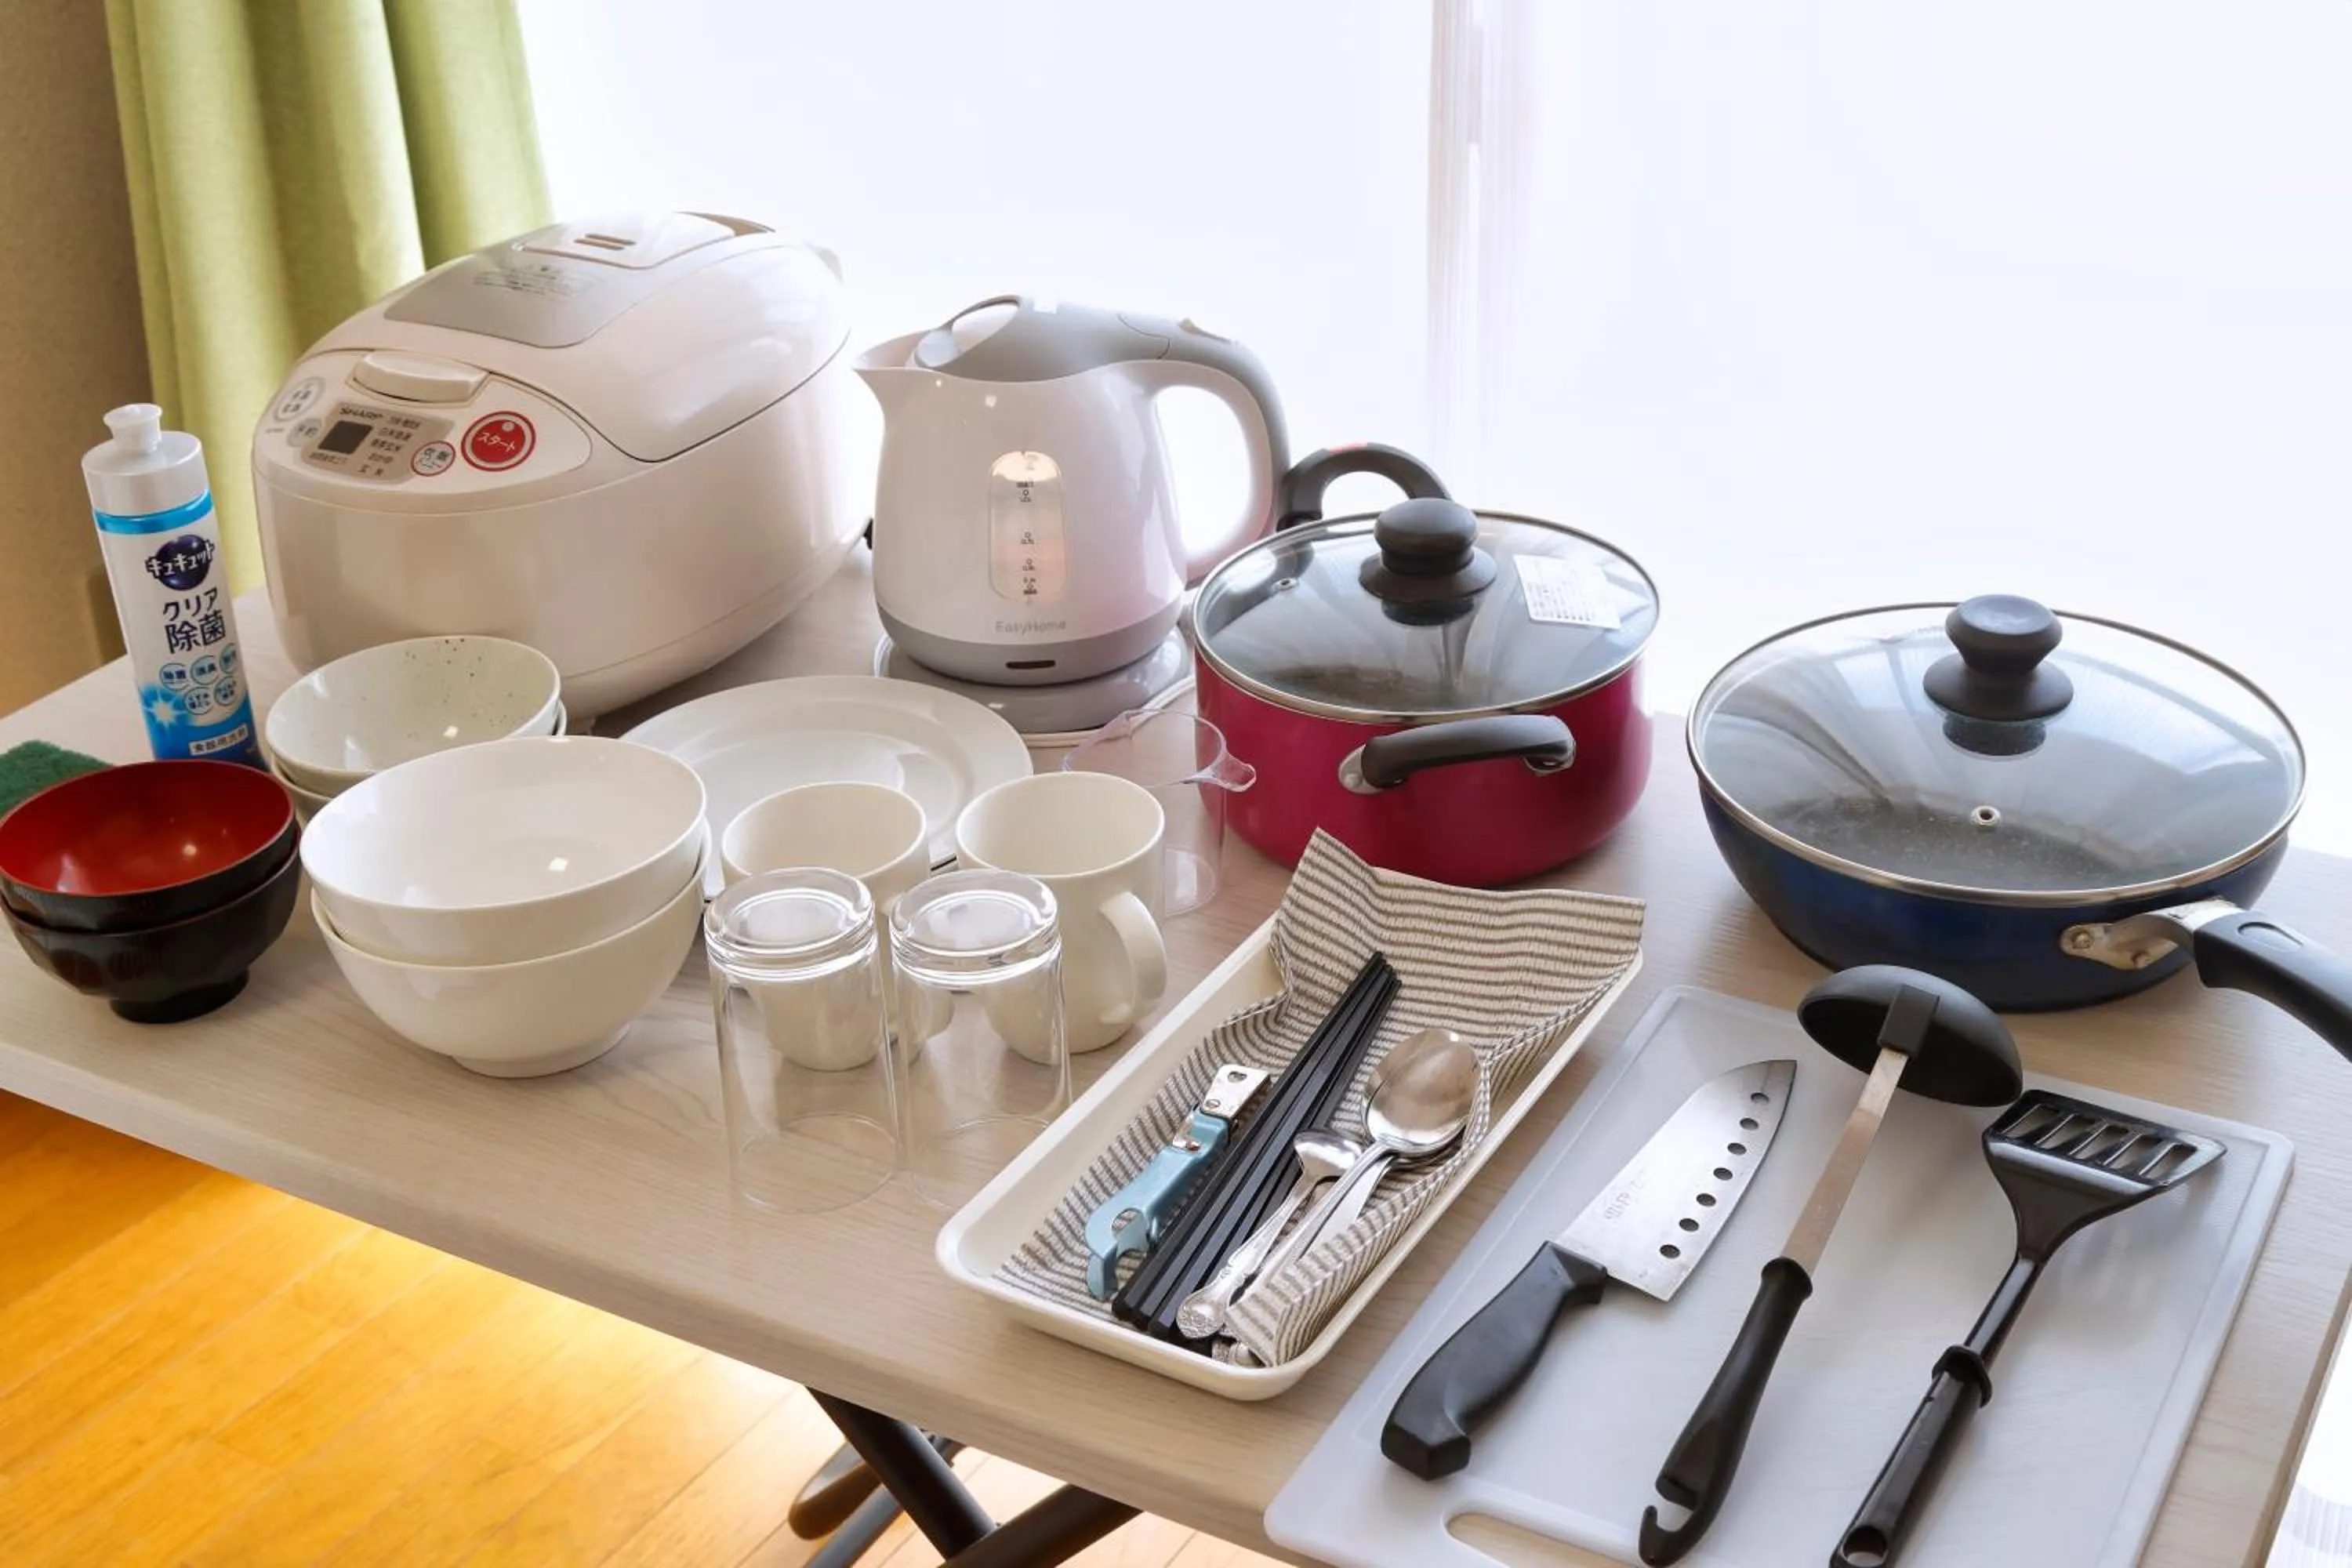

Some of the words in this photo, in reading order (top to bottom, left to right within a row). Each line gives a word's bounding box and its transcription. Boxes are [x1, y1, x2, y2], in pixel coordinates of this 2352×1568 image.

[477, 432, 516, 453] スタート
[145, 539, 216, 579] キュキュット
[163, 586, 218, 622] クリア
[165, 609, 227, 655] 除菌
[995, 619, 1066, 637] EasyHome
